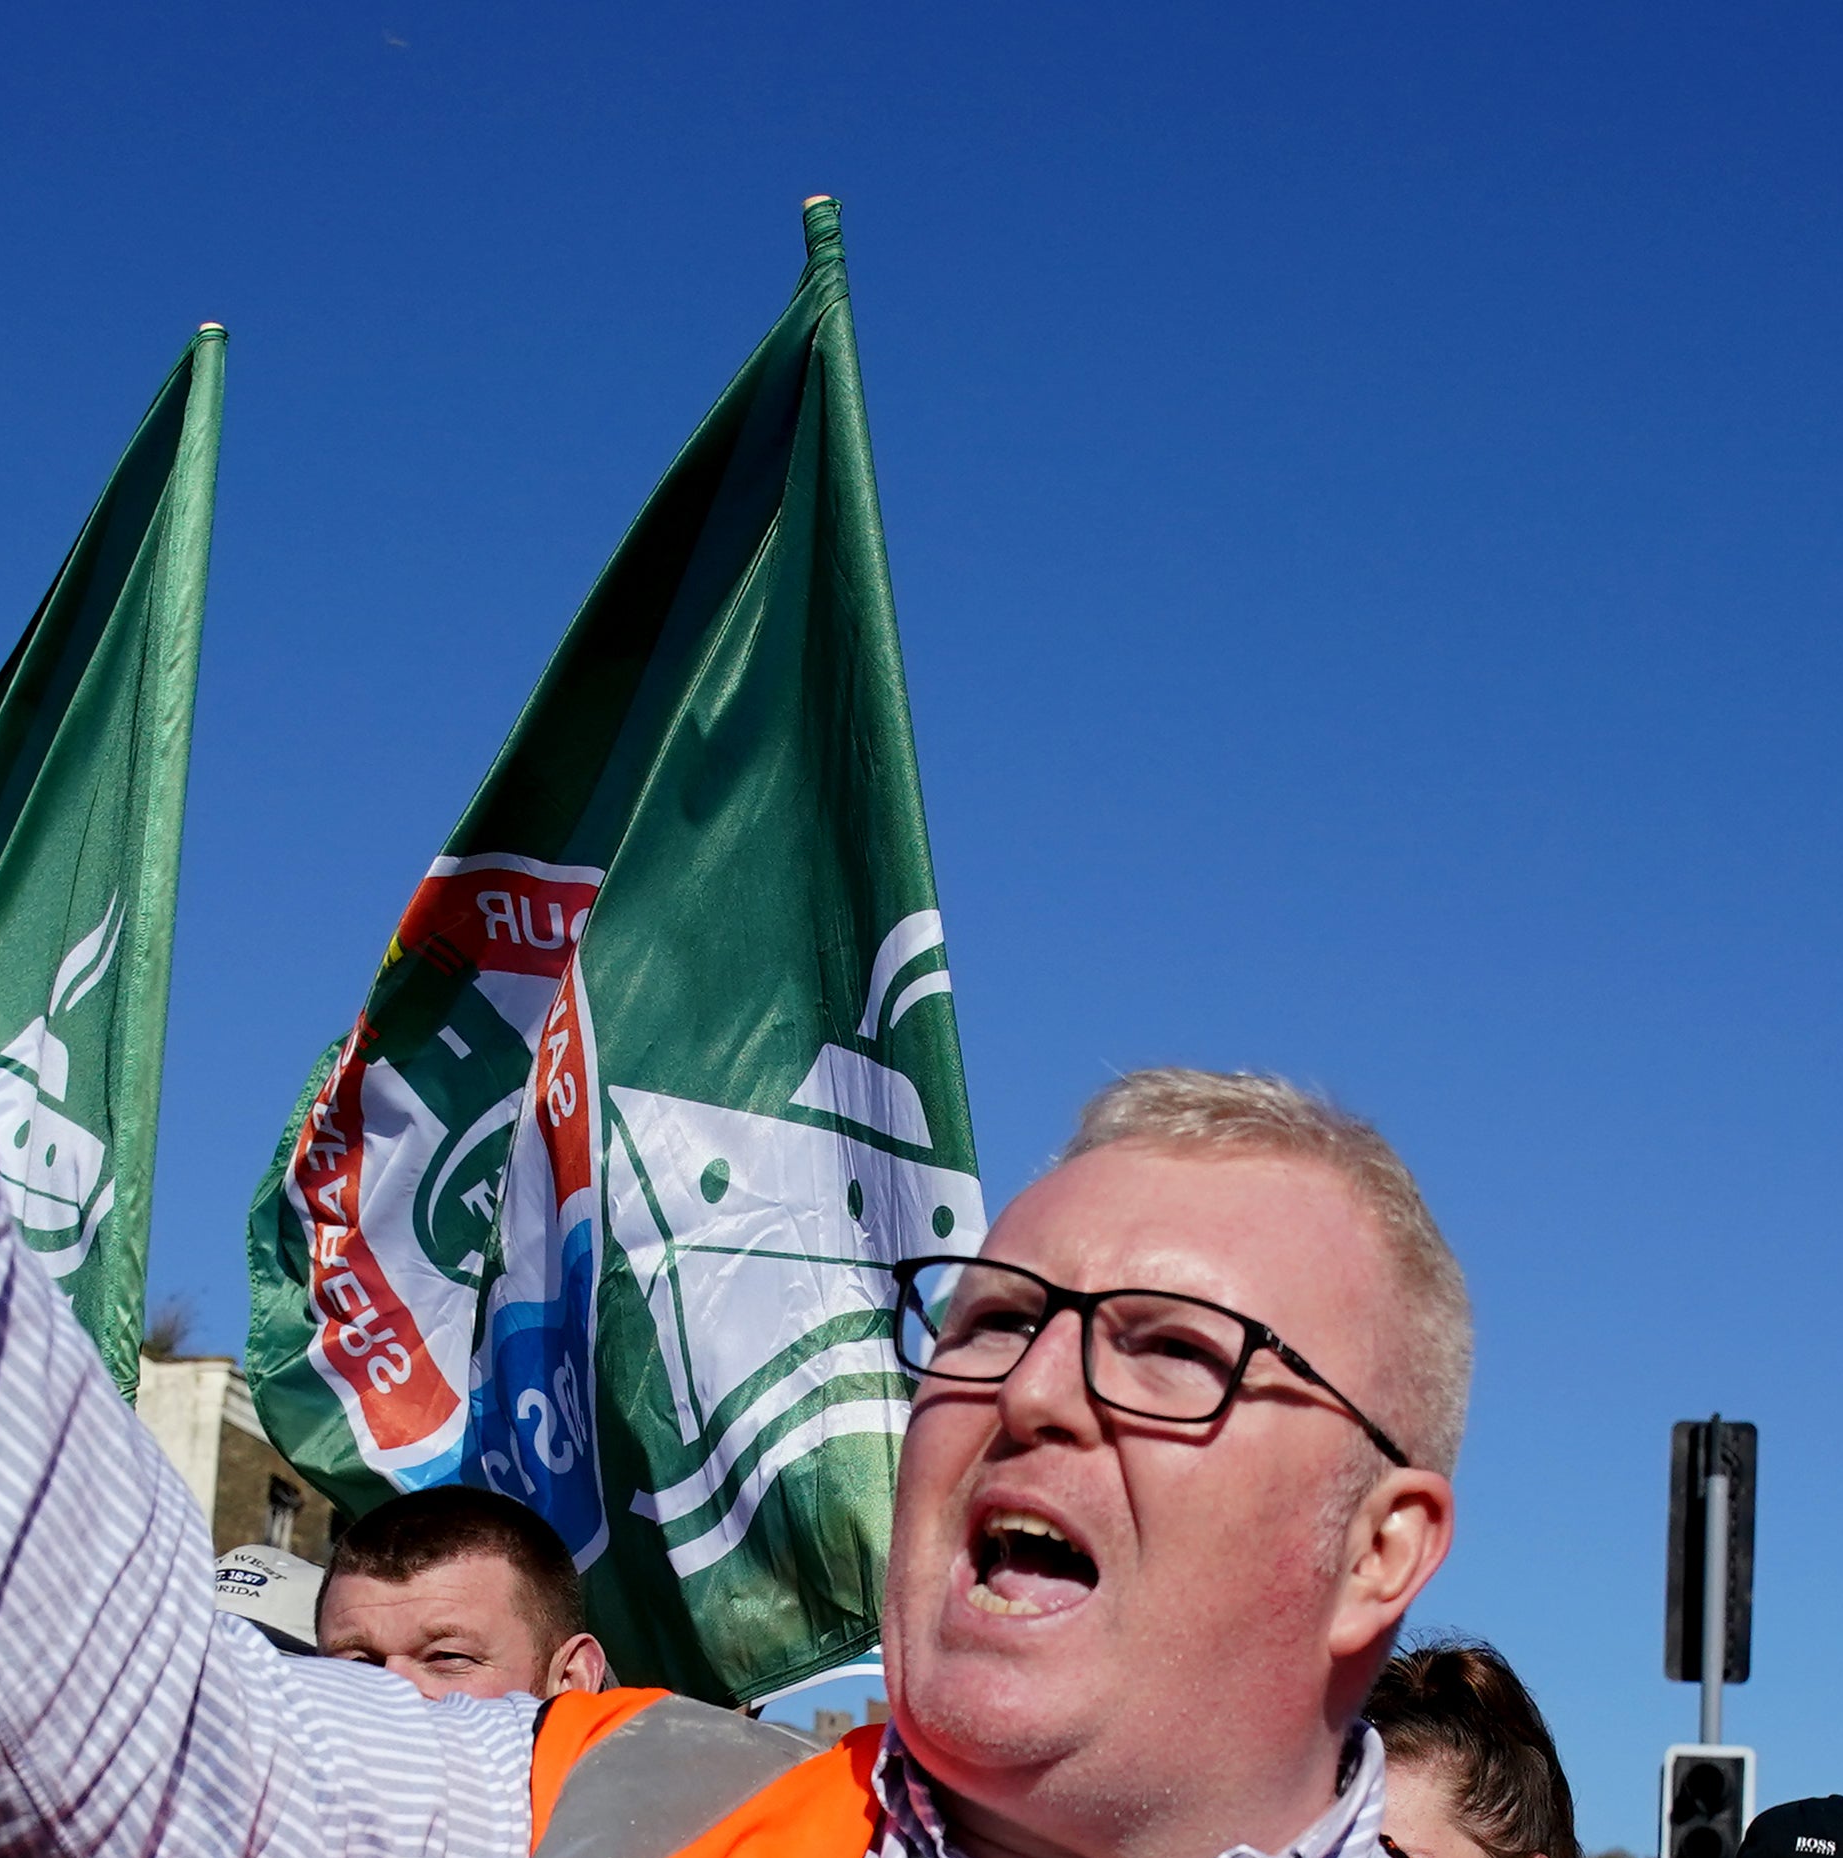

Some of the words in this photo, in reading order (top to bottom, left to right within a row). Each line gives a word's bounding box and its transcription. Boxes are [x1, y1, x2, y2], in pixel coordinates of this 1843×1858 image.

[227, 1570, 261, 1584] 1847
[215, 1584, 261, 1598] RIDA
[1796, 1836, 1836, 1851] BOSS
